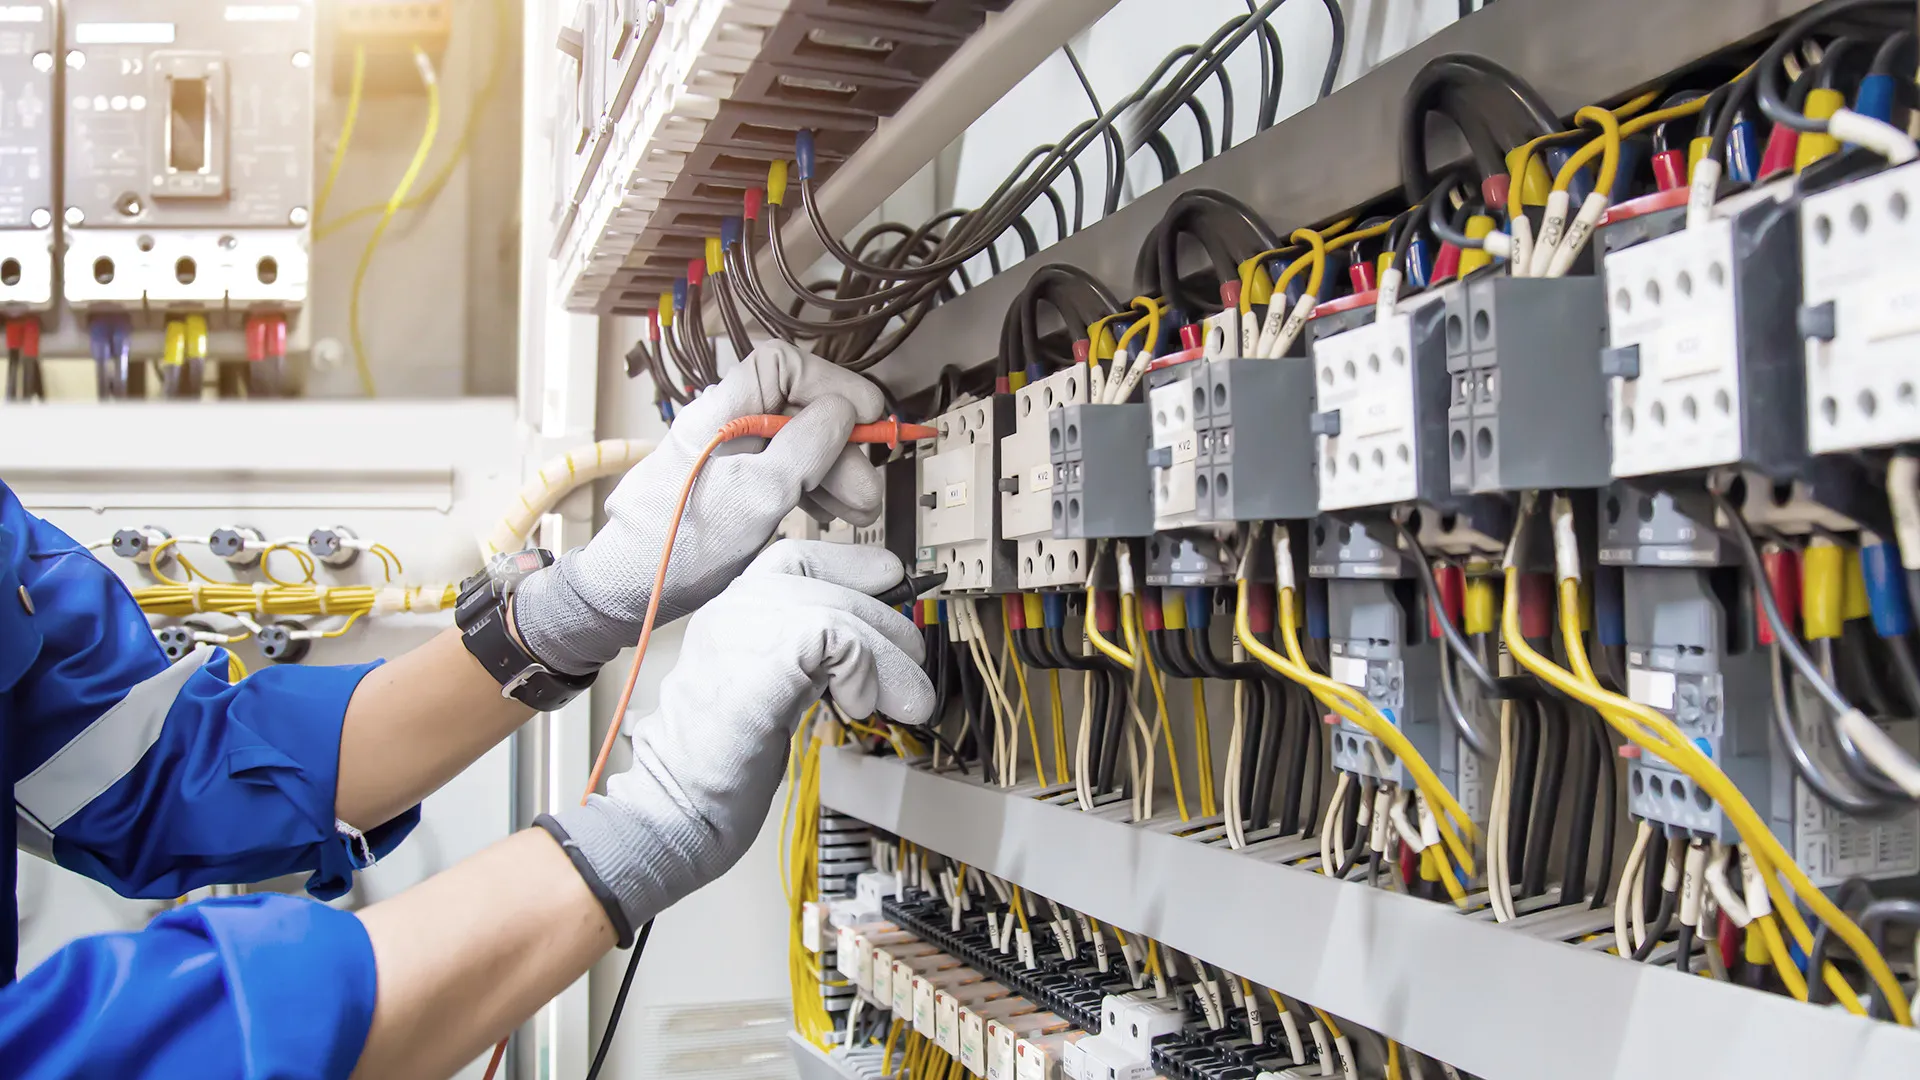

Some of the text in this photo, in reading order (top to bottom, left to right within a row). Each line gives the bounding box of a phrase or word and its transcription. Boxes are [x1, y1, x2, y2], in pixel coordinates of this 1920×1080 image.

[1178, 439, 1191, 451] KV2
[1037, 471, 1049, 481] KV2
[1097, 943, 1106, 958] 143
[1250, 1009, 1260, 1027] 143
